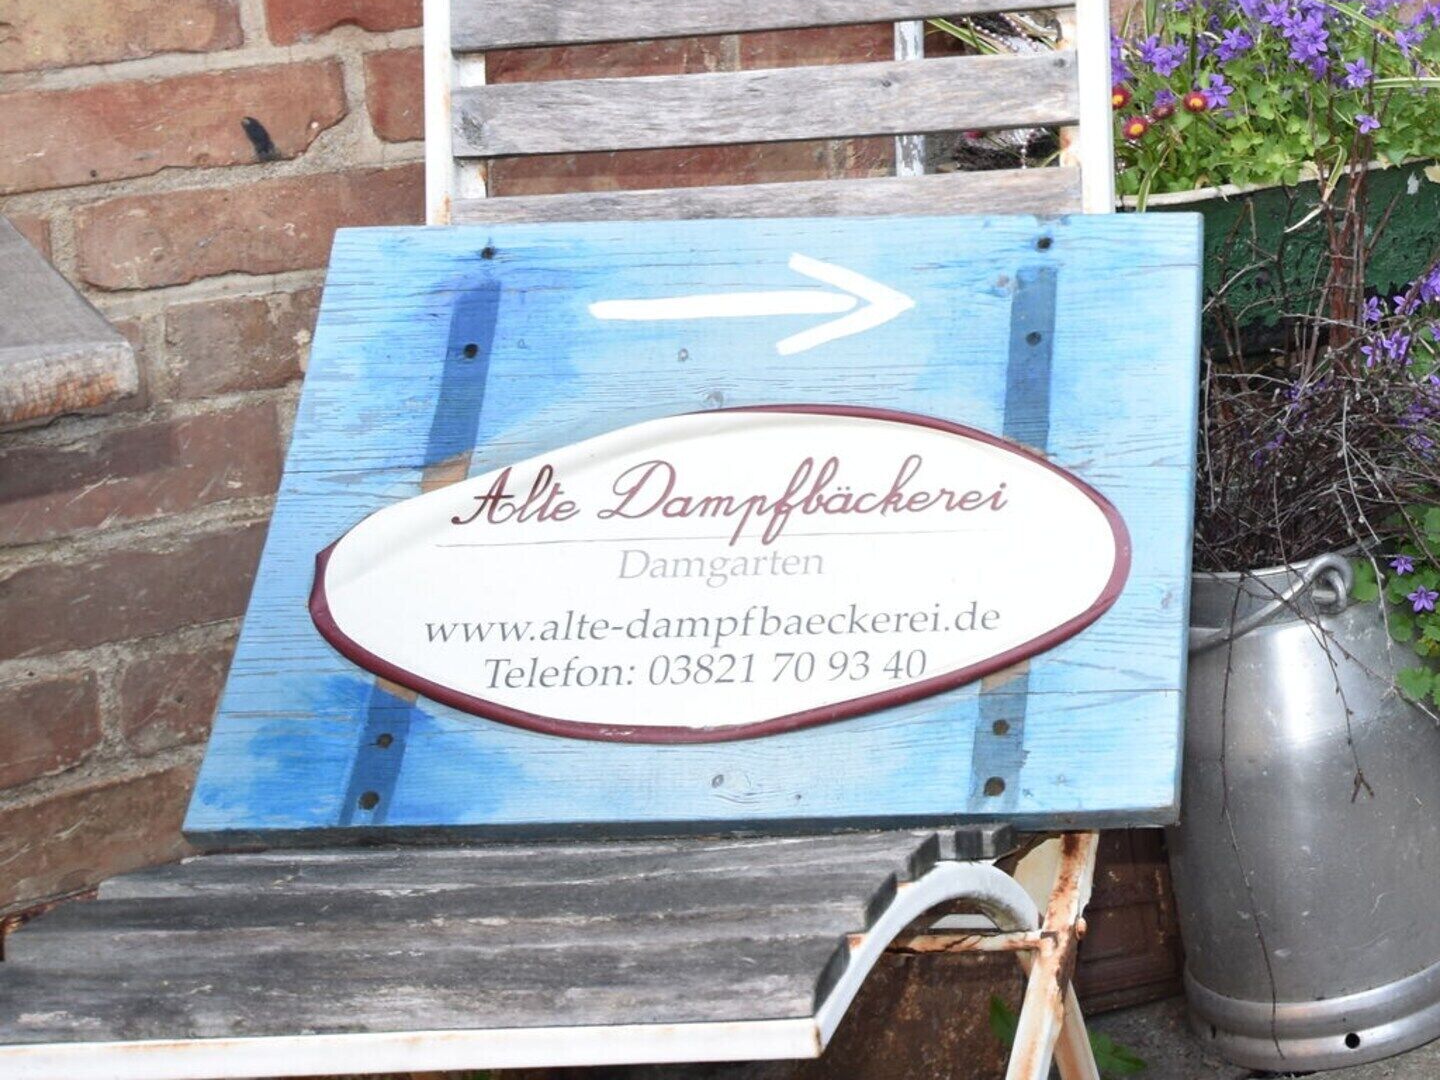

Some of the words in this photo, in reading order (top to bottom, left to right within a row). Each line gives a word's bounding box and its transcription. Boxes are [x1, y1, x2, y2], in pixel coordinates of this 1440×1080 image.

[450, 463, 581, 525] Alte
[596, 453, 1009, 547] Dampfbäckerei
[617, 548, 824, 589] Damgarten
[424, 600, 1002, 649] www.alte-dampfbaeckerei.de
[484, 655, 636, 689] Telefon:
[648, 652, 756, 686] 03821
[771, 651, 816, 683] 70
[827, 649, 871, 682] 93
[882, 648, 927, 680] 40
